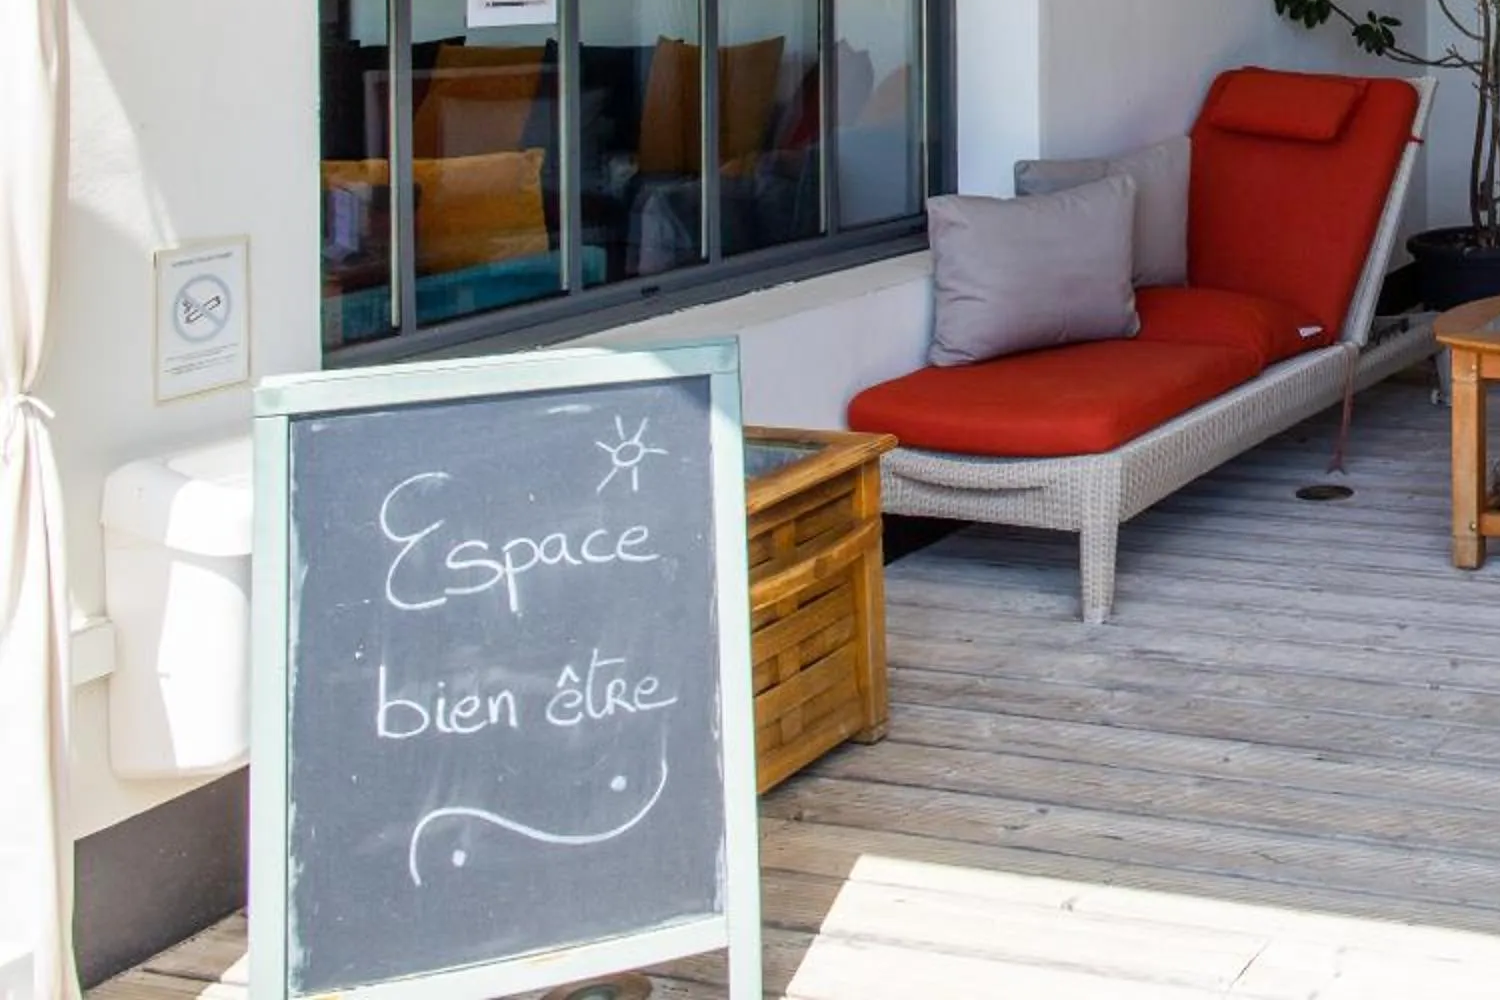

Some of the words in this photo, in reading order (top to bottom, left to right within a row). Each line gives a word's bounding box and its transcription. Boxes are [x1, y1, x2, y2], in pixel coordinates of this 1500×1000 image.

[379, 470, 660, 613] Espace
[377, 663, 519, 738] bien
[545, 647, 679, 726] être
